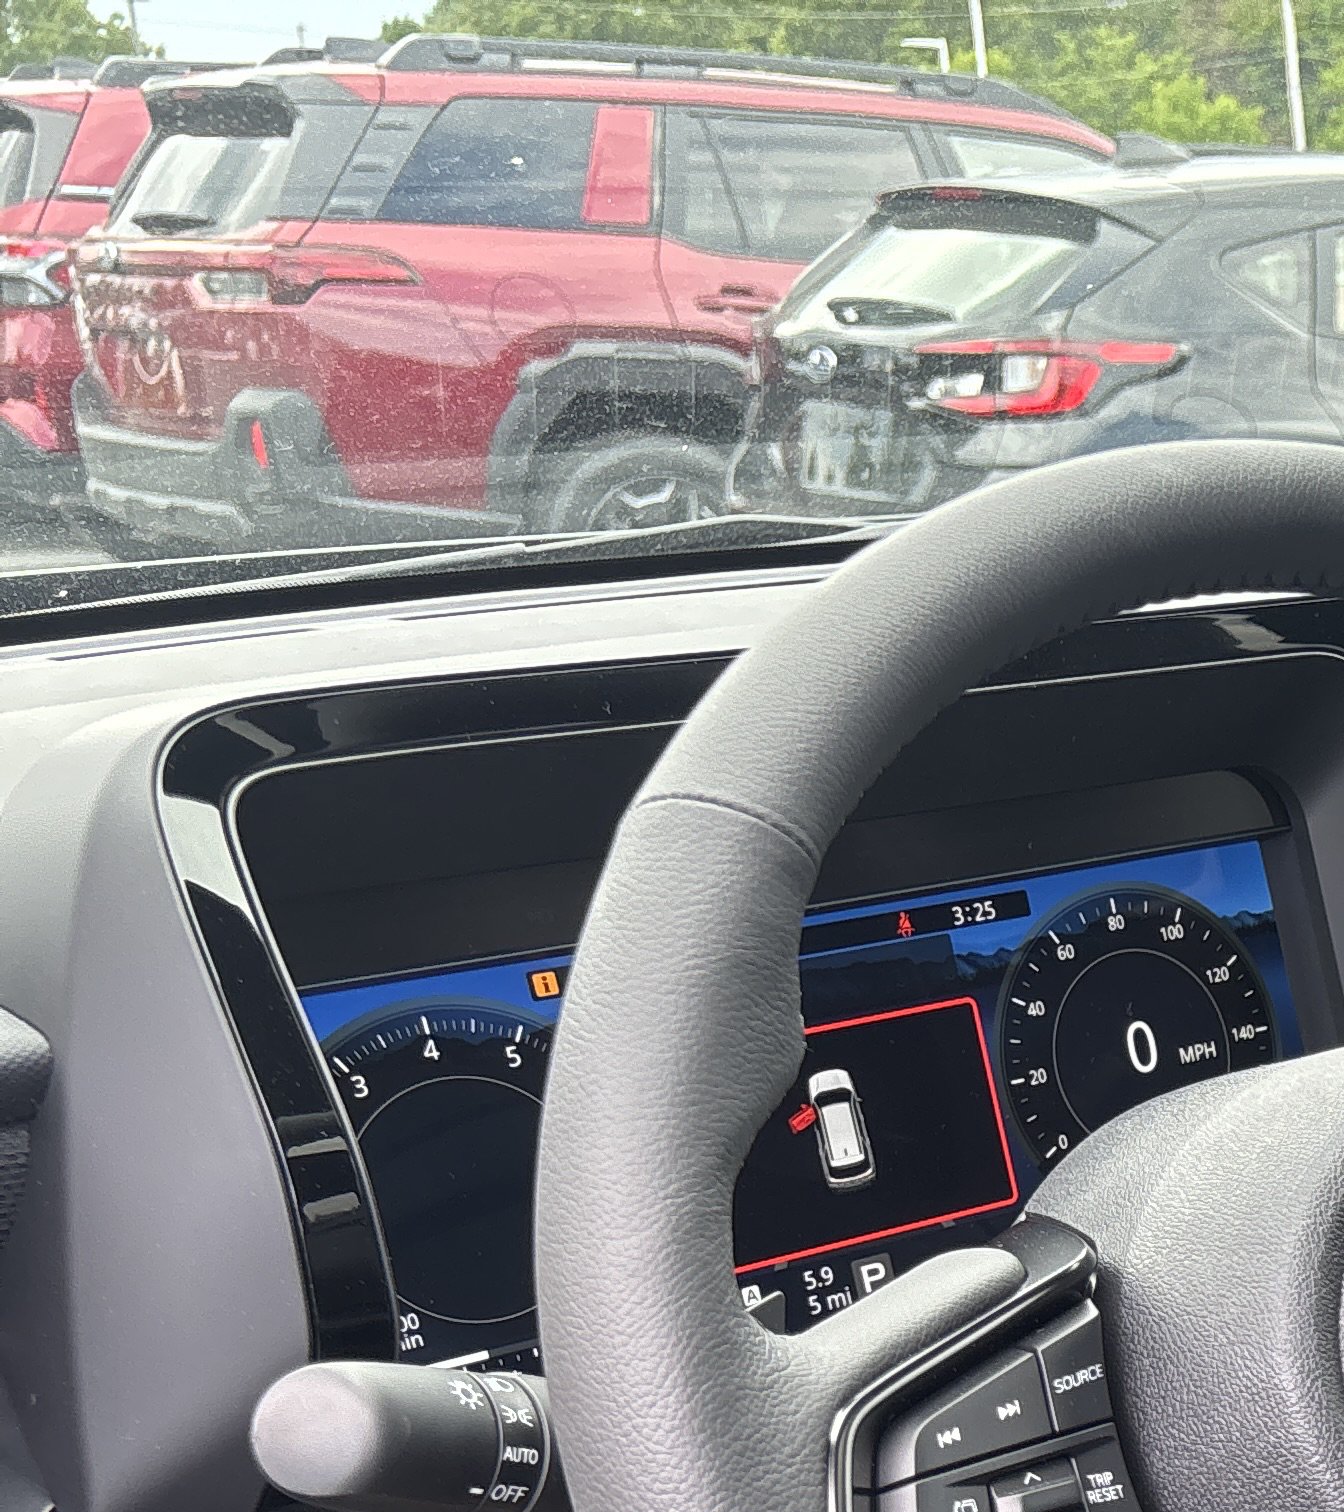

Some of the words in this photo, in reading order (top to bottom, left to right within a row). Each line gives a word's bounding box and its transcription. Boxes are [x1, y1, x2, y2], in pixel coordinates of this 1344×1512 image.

[951, 901, 996, 926] 3:25
[1107, 915, 1125, 931] 80
[1159, 924, 1185, 942] 100
[1057, 944, 1076, 961] 60
[1206, 967, 1230, 984] 120
[1027, 1001, 1046, 1017] 40
[1231, 1025, 1256, 1042] 140
[422, 1040, 441, 1061] 4
[504, 1045, 523, 1068] 5
[1126, 1020, 1158, 1073] 0
[1178, 1041, 1218, 1065] MPH
[1029, 1067, 1048, 1085] 20
[349, 1075, 370, 1098] 3
[1057, 1135, 1069, 1150] 0
[803, 1266, 834, 1291] 5.9
[860, 1262, 886, 1294] P
[807, 1295, 822, 1316] 5
[825, 1285, 853, 1311] mi
[1053, 1363, 1105, 1395] SOURCE
[502, 1446, 540, 1465] AUTO
[1086, 1471, 1114, 1489] TRIP
[490, 1484, 529, 1504] OFF
[1086, 1484, 1124, 1504] RESET
